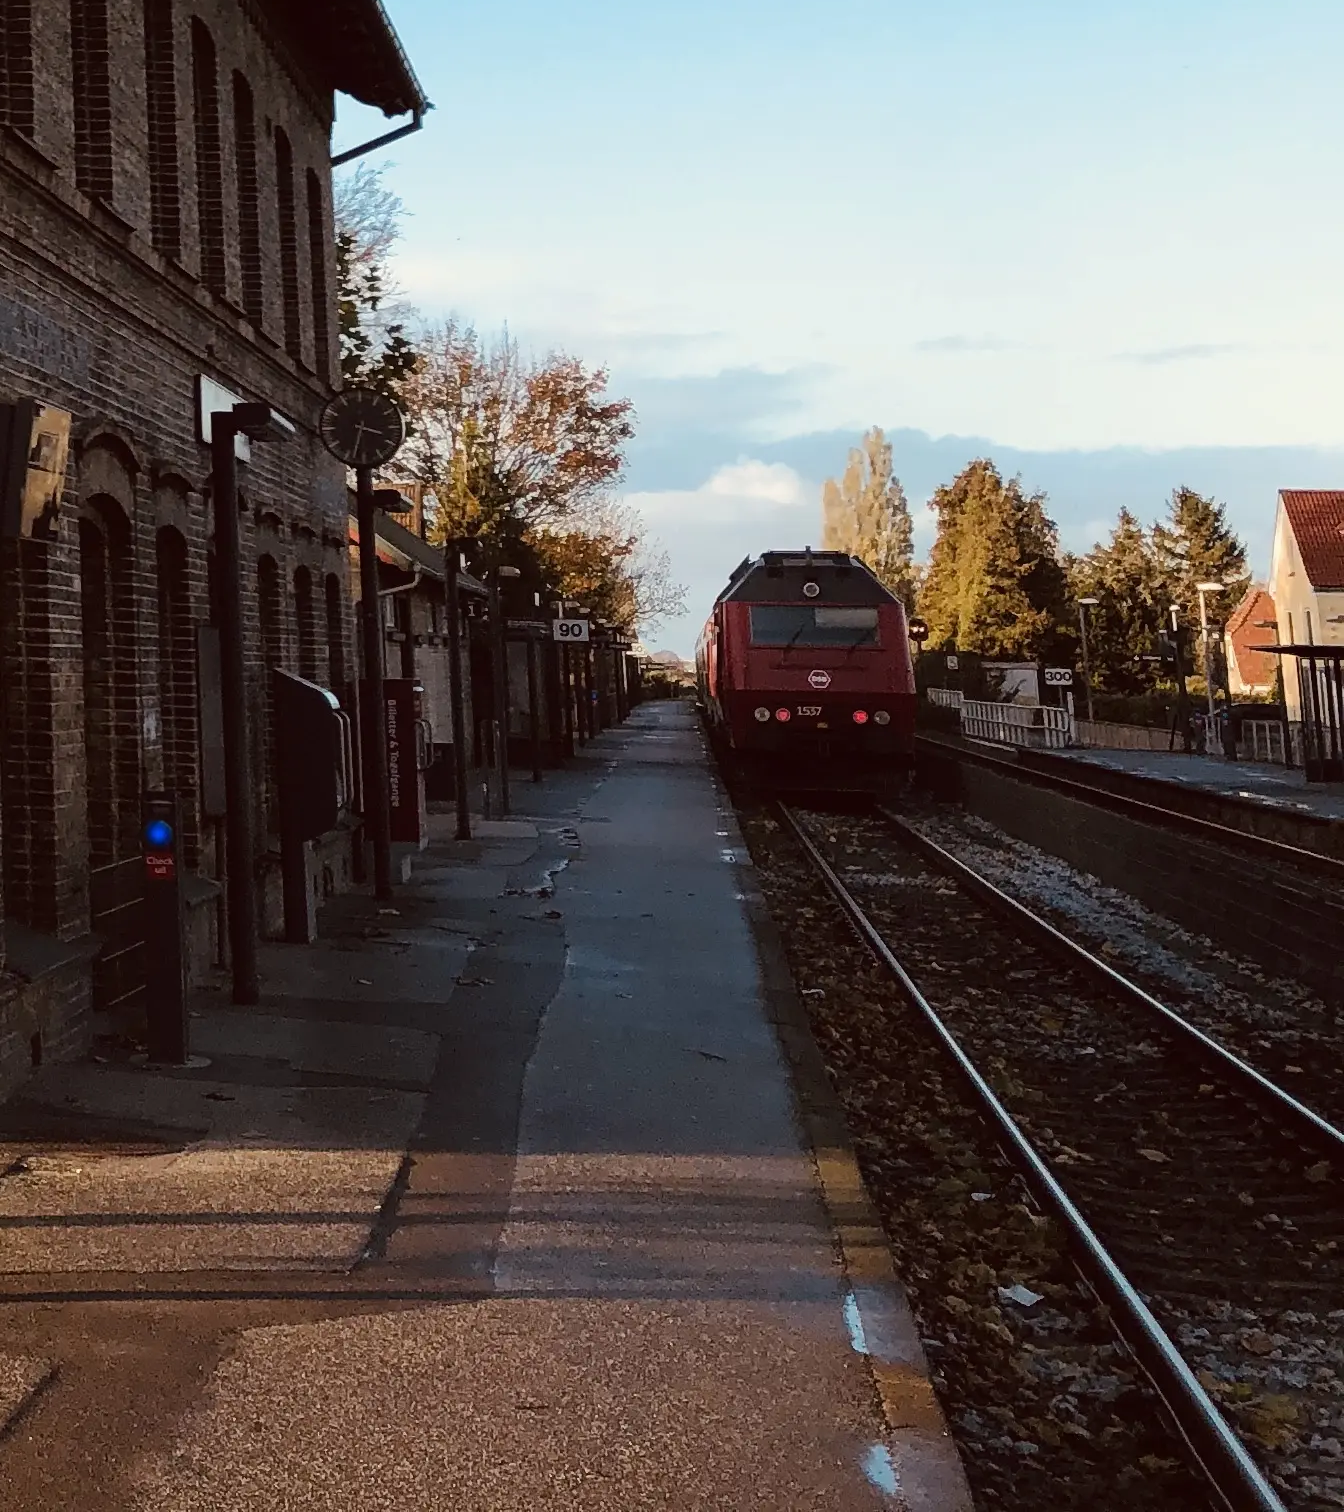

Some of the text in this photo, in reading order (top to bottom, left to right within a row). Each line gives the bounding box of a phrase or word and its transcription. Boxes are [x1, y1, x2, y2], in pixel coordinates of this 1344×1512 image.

[558, 623, 583, 637] 90
[1045, 671, 1072, 682] 300
[797, 706, 822, 716] 1537
[389, 740, 399, 748] &
[146, 856, 174, 865] Check
